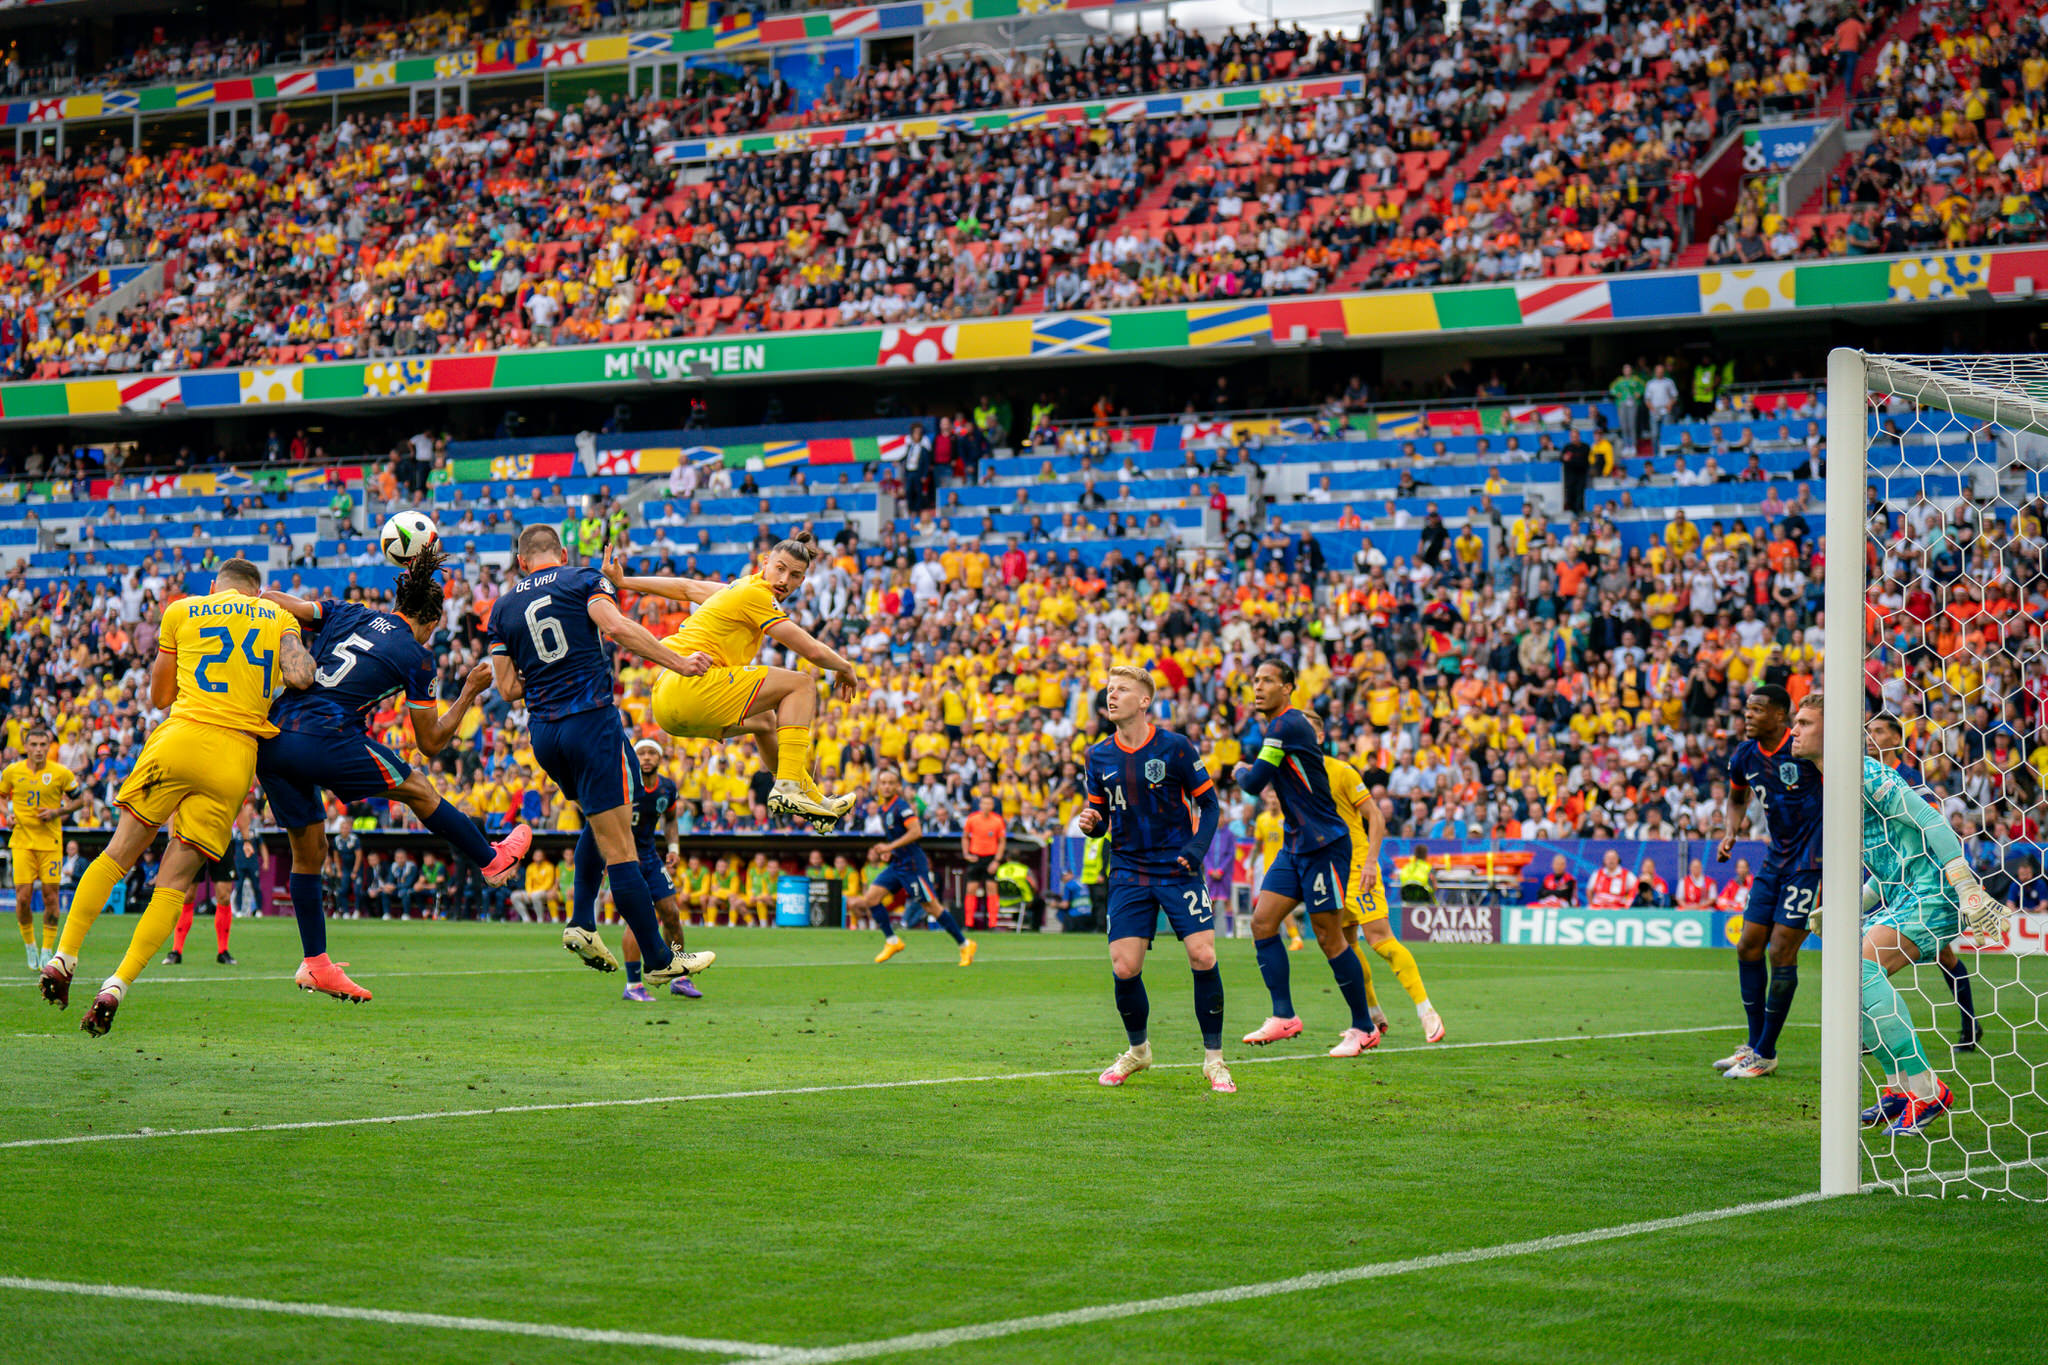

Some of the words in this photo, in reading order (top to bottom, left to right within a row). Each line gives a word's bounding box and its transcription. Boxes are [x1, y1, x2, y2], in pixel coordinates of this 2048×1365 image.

[604, 344, 765, 378] MÜNCHEN
[516, 579, 532, 593] DE
[368, 616, 398, 635] AKE
[524, 594, 569, 664] 6
[194, 626, 274, 699] 24
[314, 632, 375, 688] 5
[27, 790, 40, 807] 21
[1104, 784, 1127, 811] 24
[1755, 785, 1769, 809] 2
[49, 861, 61, 877] 21
[1312, 872, 1327, 896] 4
[1183, 889, 1213, 916] 24
[1356, 892, 1377, 915] 19
[1783, 885, 1814, 914] 22
[1410, 906, 1493, 933] QATAR
[1507, 908, 1704, 947] Hisense
[1428, 928, 1494, 944] AIRWAYS
